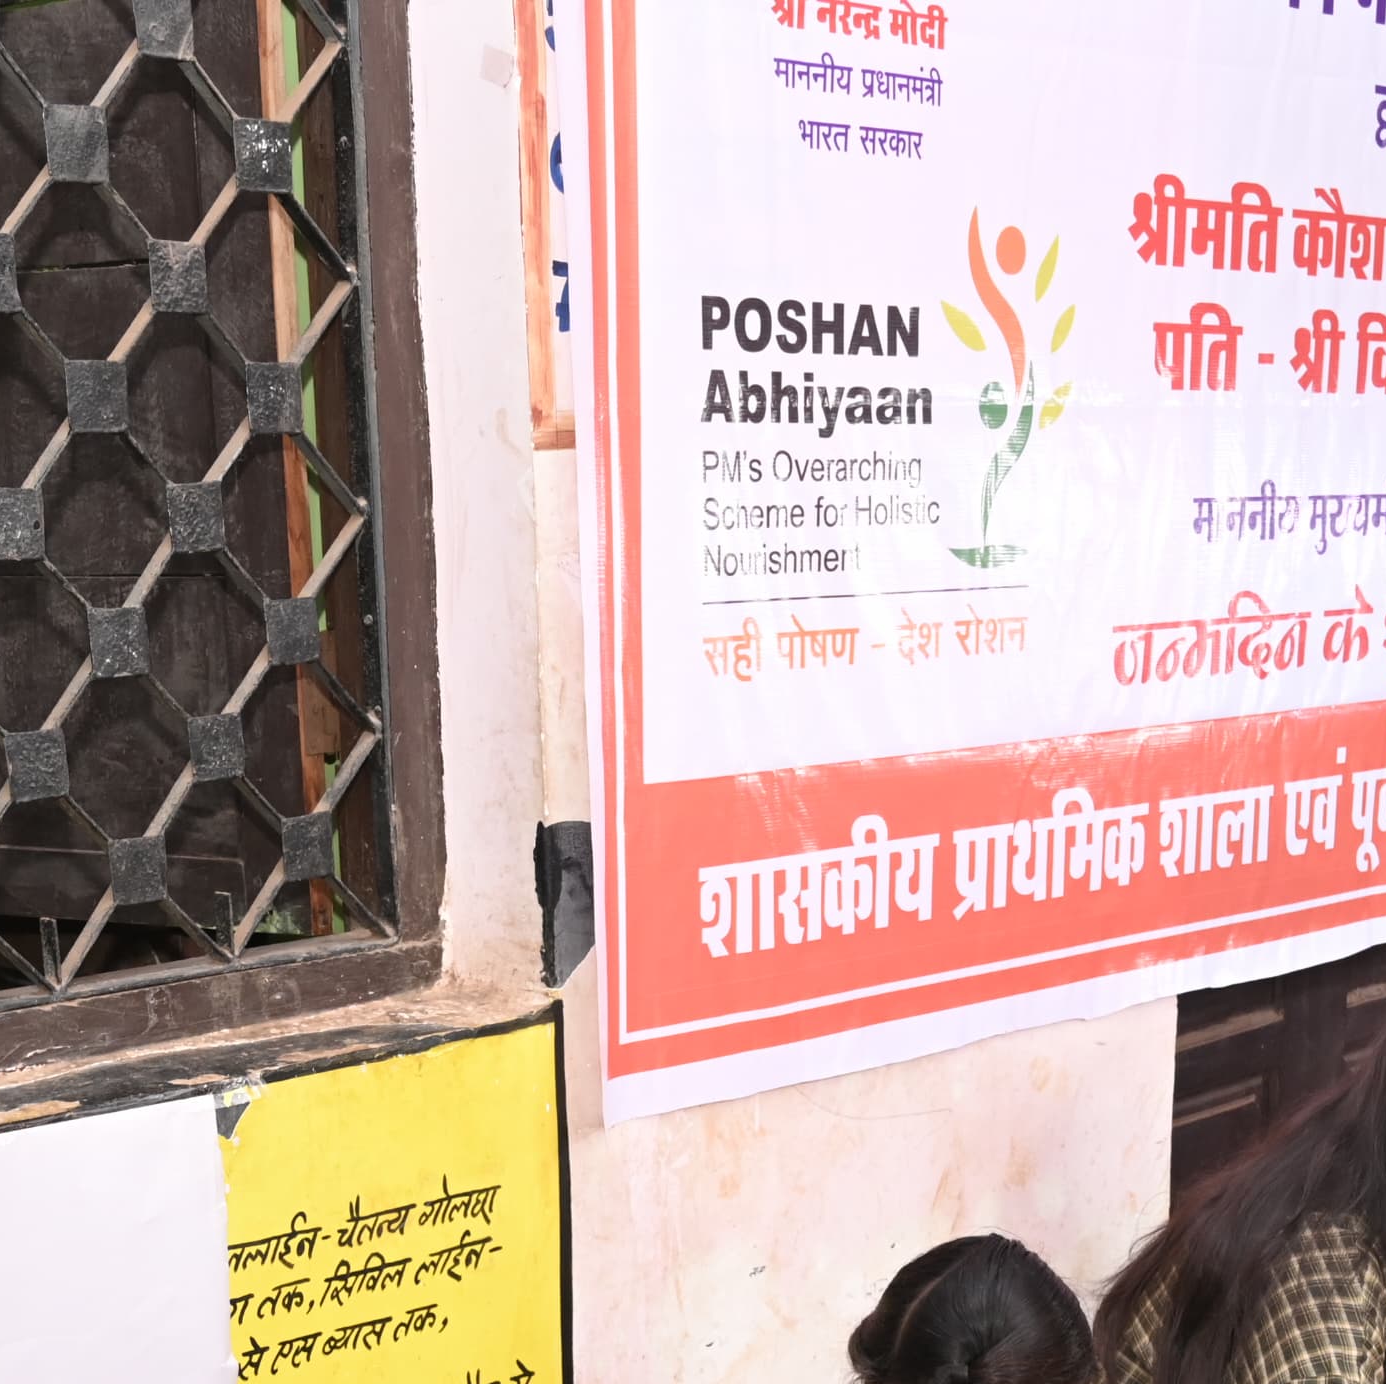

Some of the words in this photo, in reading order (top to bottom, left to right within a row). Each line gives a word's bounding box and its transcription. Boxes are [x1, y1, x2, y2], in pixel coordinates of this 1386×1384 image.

[816, 0, 883, 40] नरन्द्र
[889, 0, 949, 50] मोदी
[773, 52, 854, 96] माननीय
[860, 66, 943, 107] प्रधानमंत्री
[798, 119, 851, 153] भारत
[859, 126, 923, 160] सरकार
[1127, 174, 1284, 277] श्रीमति
[700, 295, 921, 358] POSHAN
[1153, 302, 1244, 392] पति
[1289, 309, 1345, 395] श्री
[700, 368, 934, 438] Abhiyaan
[772, 450, 923, 490] Overarching
[702, 496, 806, 533] Scheme
[814, 496, 849, 529] for
[855, 495, 941, 527] Holistic
[1193, 480, 1301, 543] मननीय
[703, 542, 862, 579] Nourishment
[702, 616, 762, 682] सही
[776, 613, 860, 670] पोषण
[896, 607, 944, 666] देश
[954, 603, 1029, 656] रोशन
[1112, 590, 1311, 686] जन्मदिन
[1323, 584, 1373, 663] के
[698, 814, 940, 959] शासकीय
[952, 787, 1151, 921] प्राथमिक
[1158, 780, 1273, 878] शाला
[1285, 746, 1344, 857] एवं
[319, 1252, 413, 1307] सिविल
[238, 1336, 269, 1381] से
